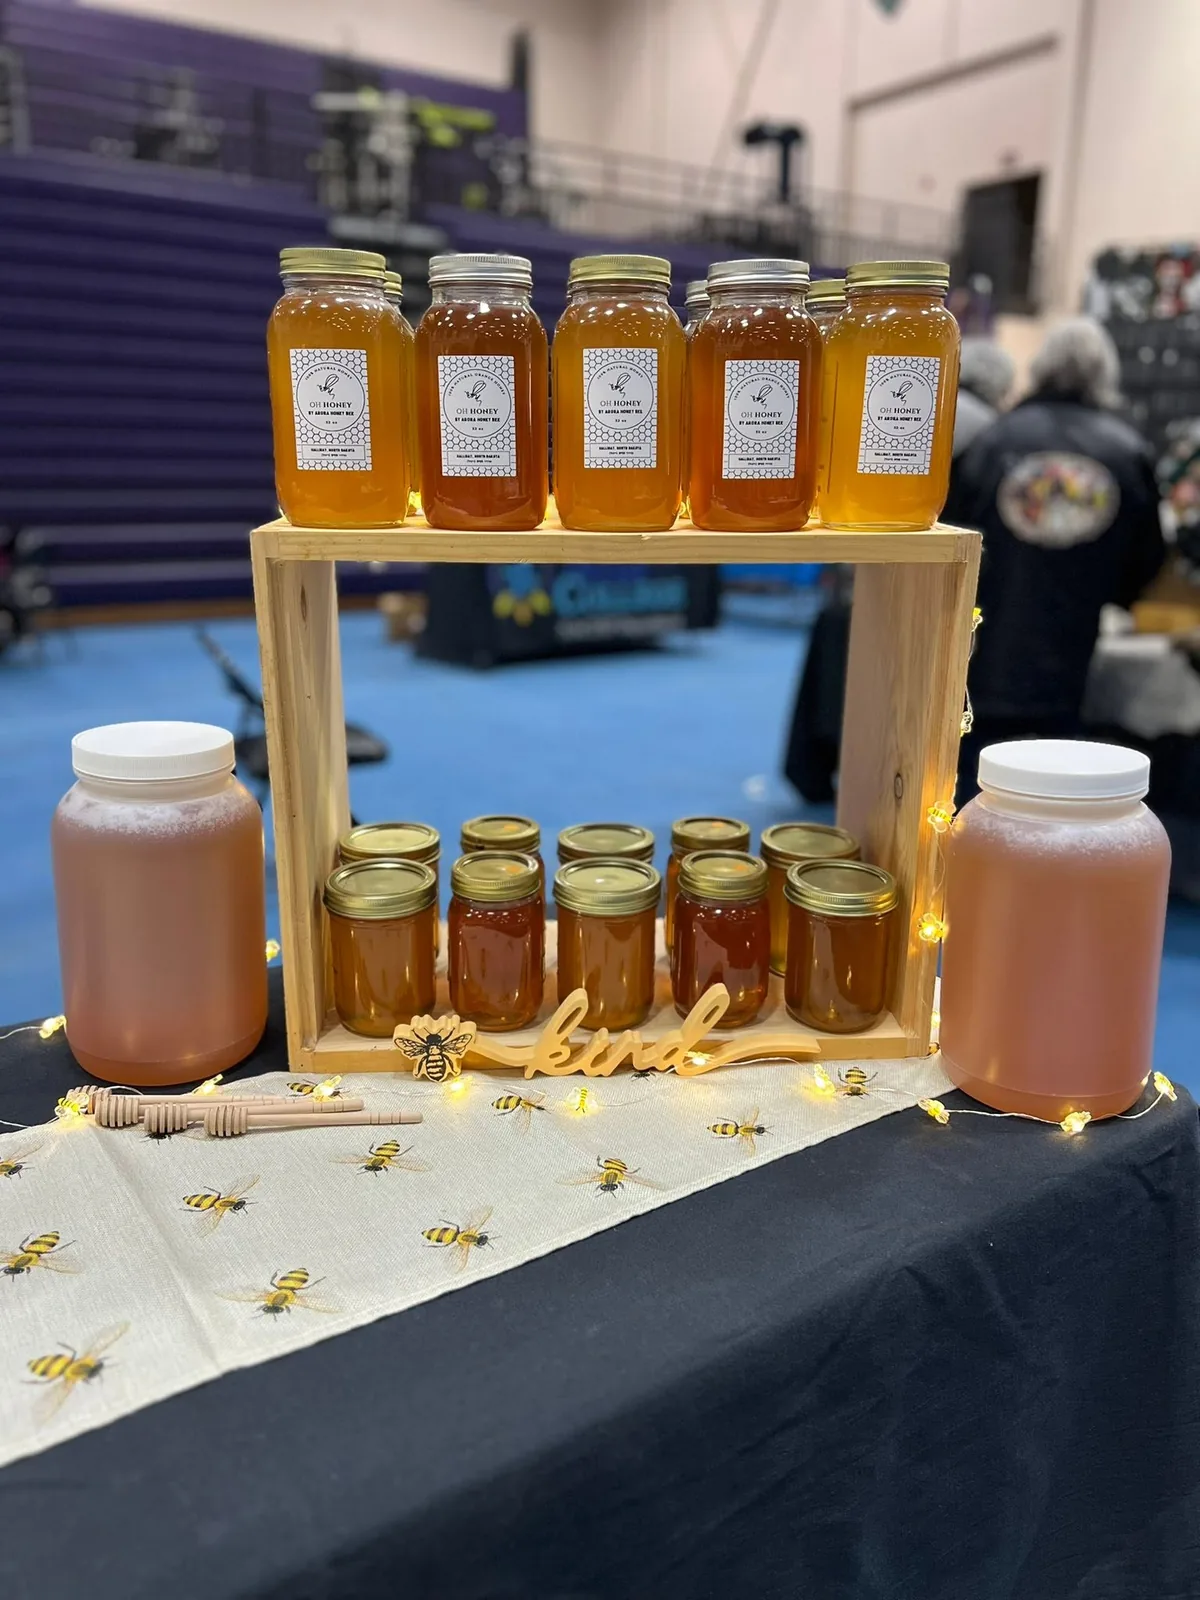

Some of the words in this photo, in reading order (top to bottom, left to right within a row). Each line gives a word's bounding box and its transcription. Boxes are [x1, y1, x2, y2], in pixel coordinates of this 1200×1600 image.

[338, 369, 352, 380] HONEY
[630, 367, 643, 378] HONEY
[912, 375, 925, 387] HONEY
[454, 373, 473, 386] NATURAL
[475, 373, 493, 381] ORANGE
[494, 381, 505, 395] HONEY
[740, 377, 760, 390] NATURAL
[762, 377, 780, 385] ORANGE
[780, 384, 790, 399] HONEY
[524, 984, 730, 1079] kind
